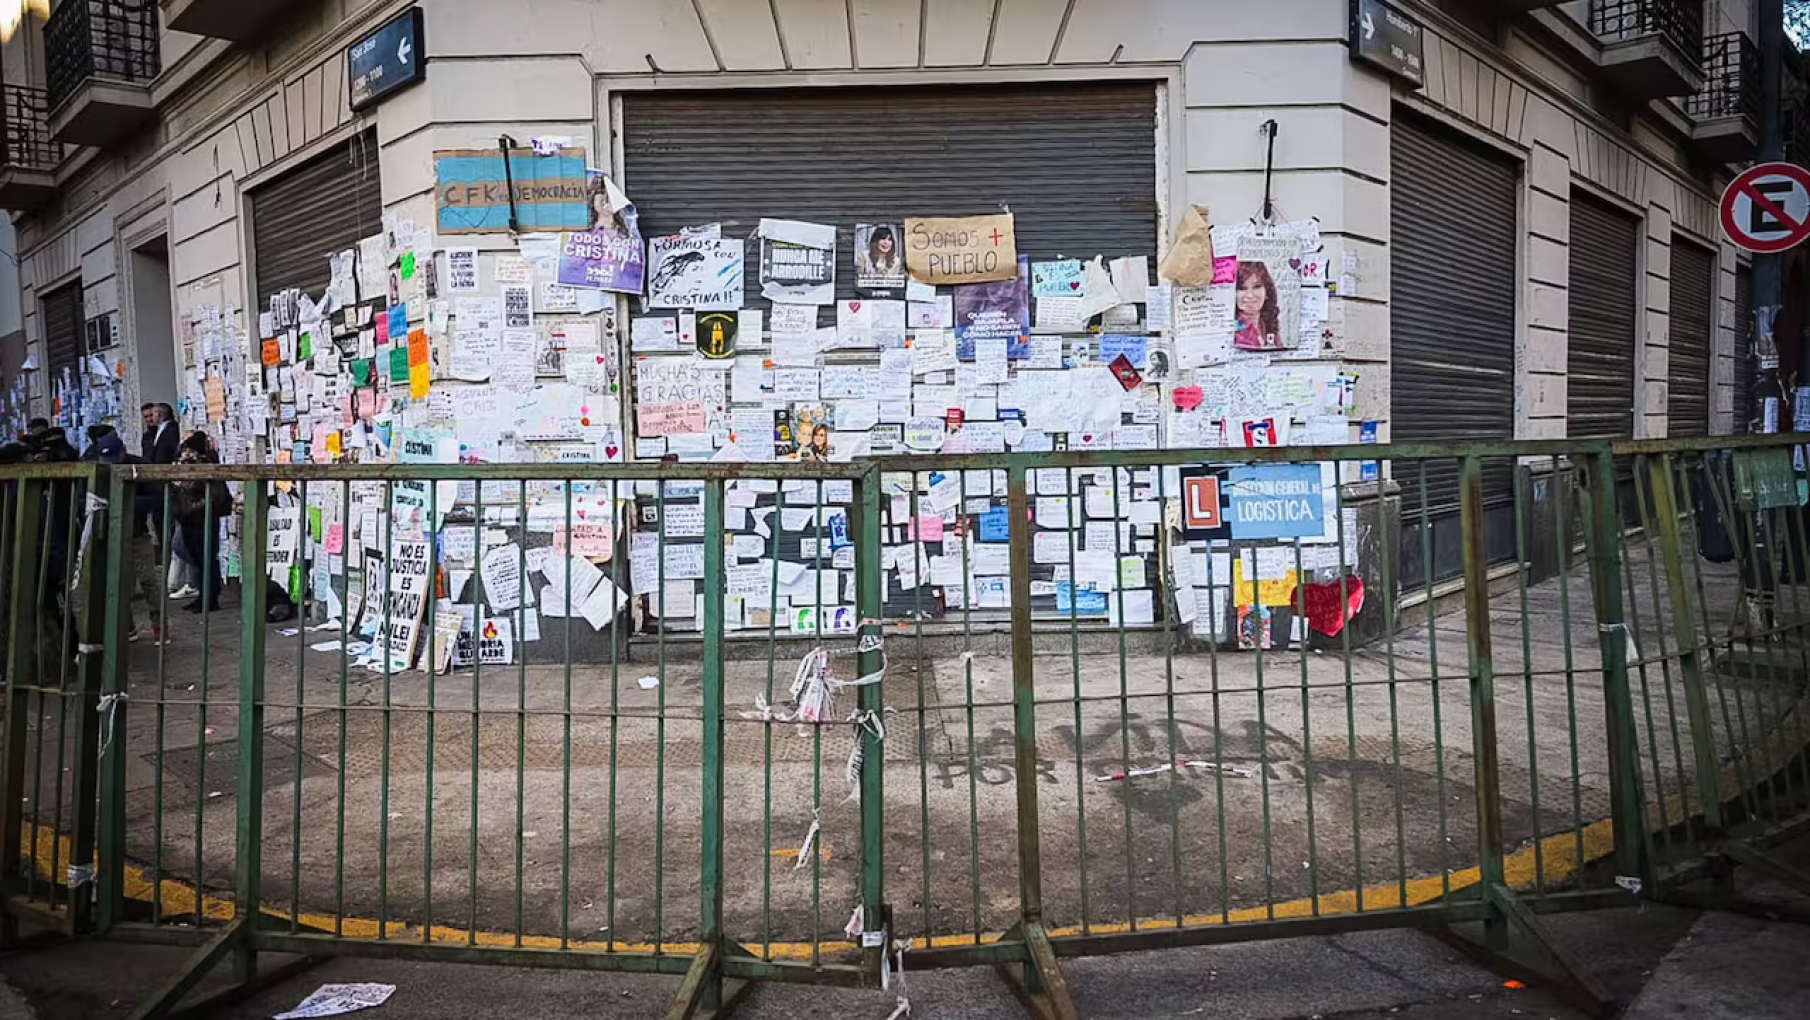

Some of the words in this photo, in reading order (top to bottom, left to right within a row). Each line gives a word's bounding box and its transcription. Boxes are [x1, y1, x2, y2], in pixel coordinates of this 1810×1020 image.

[445, 184, 496, 204] CFK
[567, 233, 610, 247] TODOS
[613, 237, 640, 250] CON
[655, 240, 721, 253] FORMOSA
[563, 244, 641, 264] CRISTINA
[929, 251, 998, 277] PUEBLO
[641, 384, 724, 404] GRACIAS
[1191, 483, 1212, 519] L
[1237, 499, 1314, 523] LOGISTICA
[399, 544, 413, 559] NO
[414, 544, 425, 560] ES
[401, 576, 413, 591] ES
